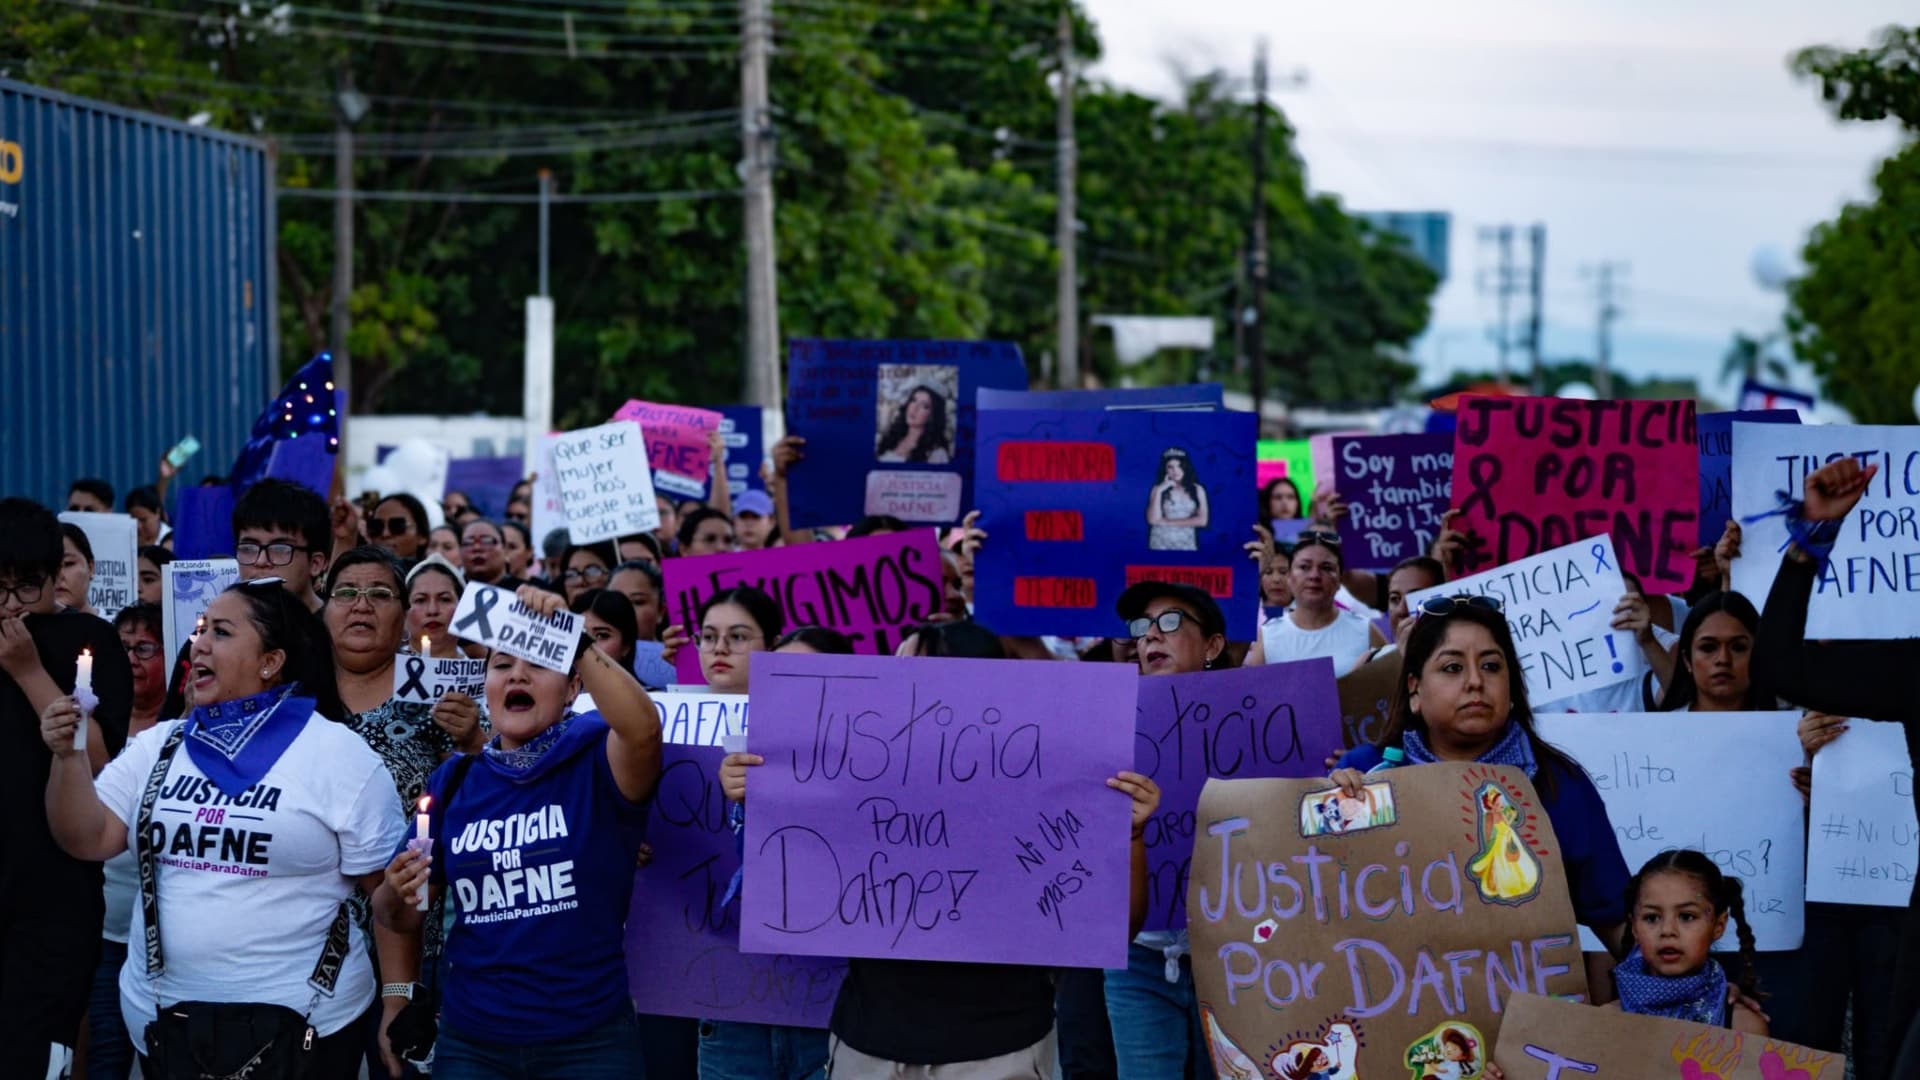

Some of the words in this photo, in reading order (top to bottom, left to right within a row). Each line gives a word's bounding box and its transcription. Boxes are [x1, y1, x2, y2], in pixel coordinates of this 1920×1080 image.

[555, 439, 592, 460] Que
[600, 433, 626, 450] ser
[1342, 441, 1395, 482] Soy
[560, 459, 614, 482] mujer
[1534, 452, 1636, 504] POR
[562, 488, 586, 502] no
[593, 475, 626, 493] nos
[627, 492, 643, 505] la
[578, 518, 619, 537] vida
[1348, 501, 1403, 530] Pido
[1860, 506, 1919, 542] POR
[1363, 531, 1404, 559] Por
[498, 624, 568, 664] DAFNE
[529, 623, 546, 635] POR
[771, 672, 1042, 787] Justicia
[195, 807, 226, 825] POR
[451, 804, 568, 854] JUSTICIA
[857, 796, 949, 848] Para
[492, 848, 522, 872] POR
[1014, 835, 1047, 874] Ni
[1199, 817, 1466, 923] Justicia
[455, 859, 576, 913] DAFNE
[464, 898, 579, 925] #JusticiaParaDafne
[1218, 942, 1326, 1009] Por
[1334, 935, 1586, 1019] DAFNE
